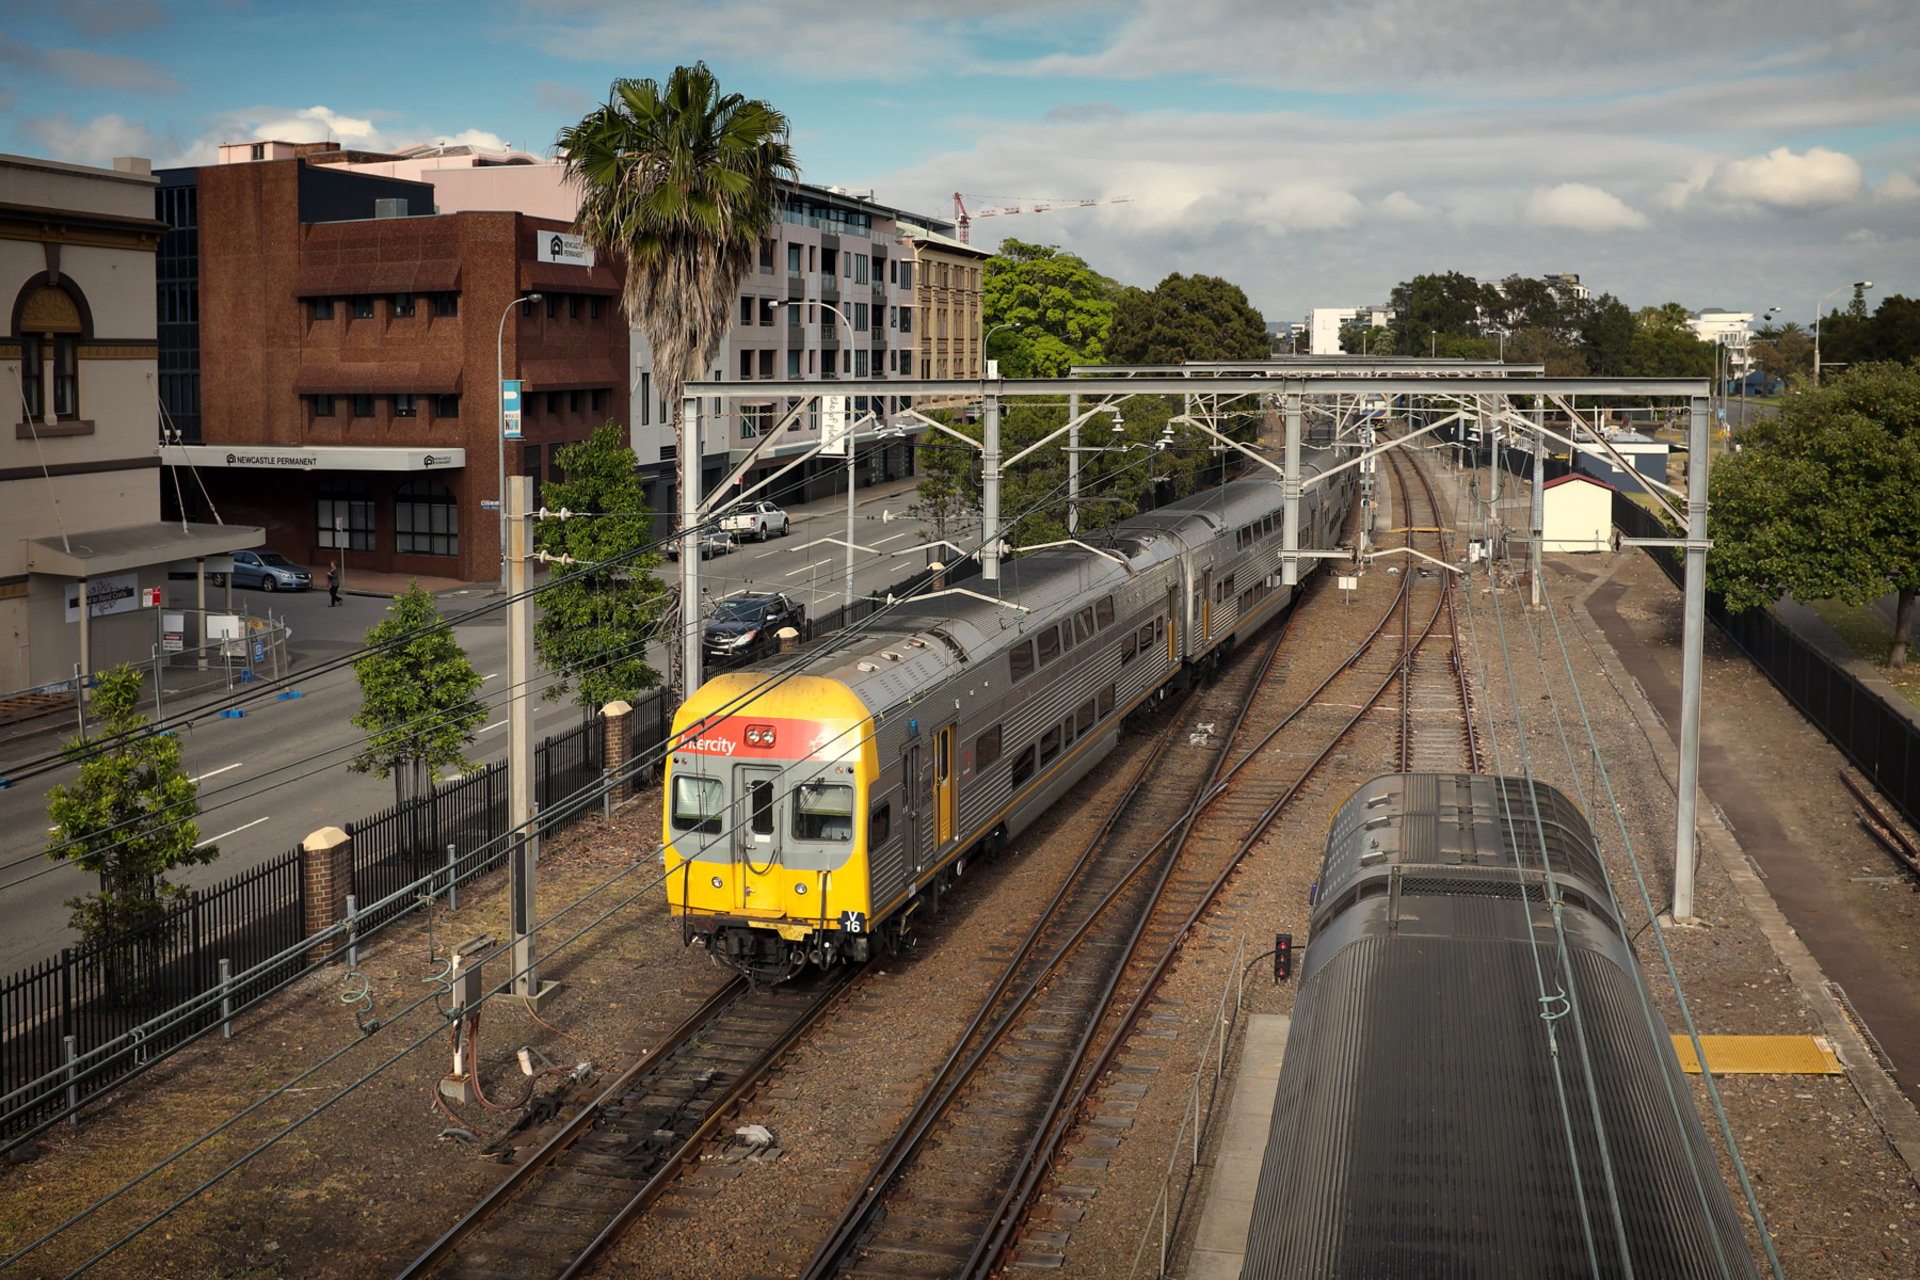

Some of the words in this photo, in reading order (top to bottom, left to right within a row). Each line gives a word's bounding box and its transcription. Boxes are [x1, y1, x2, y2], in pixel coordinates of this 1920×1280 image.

[237, 456, 275, 465] NEWCASTLE
[277, 457, 317, 466] PERMANENT
[848, 910, 858, 922] V
[844, 920, 861, 933] 16
